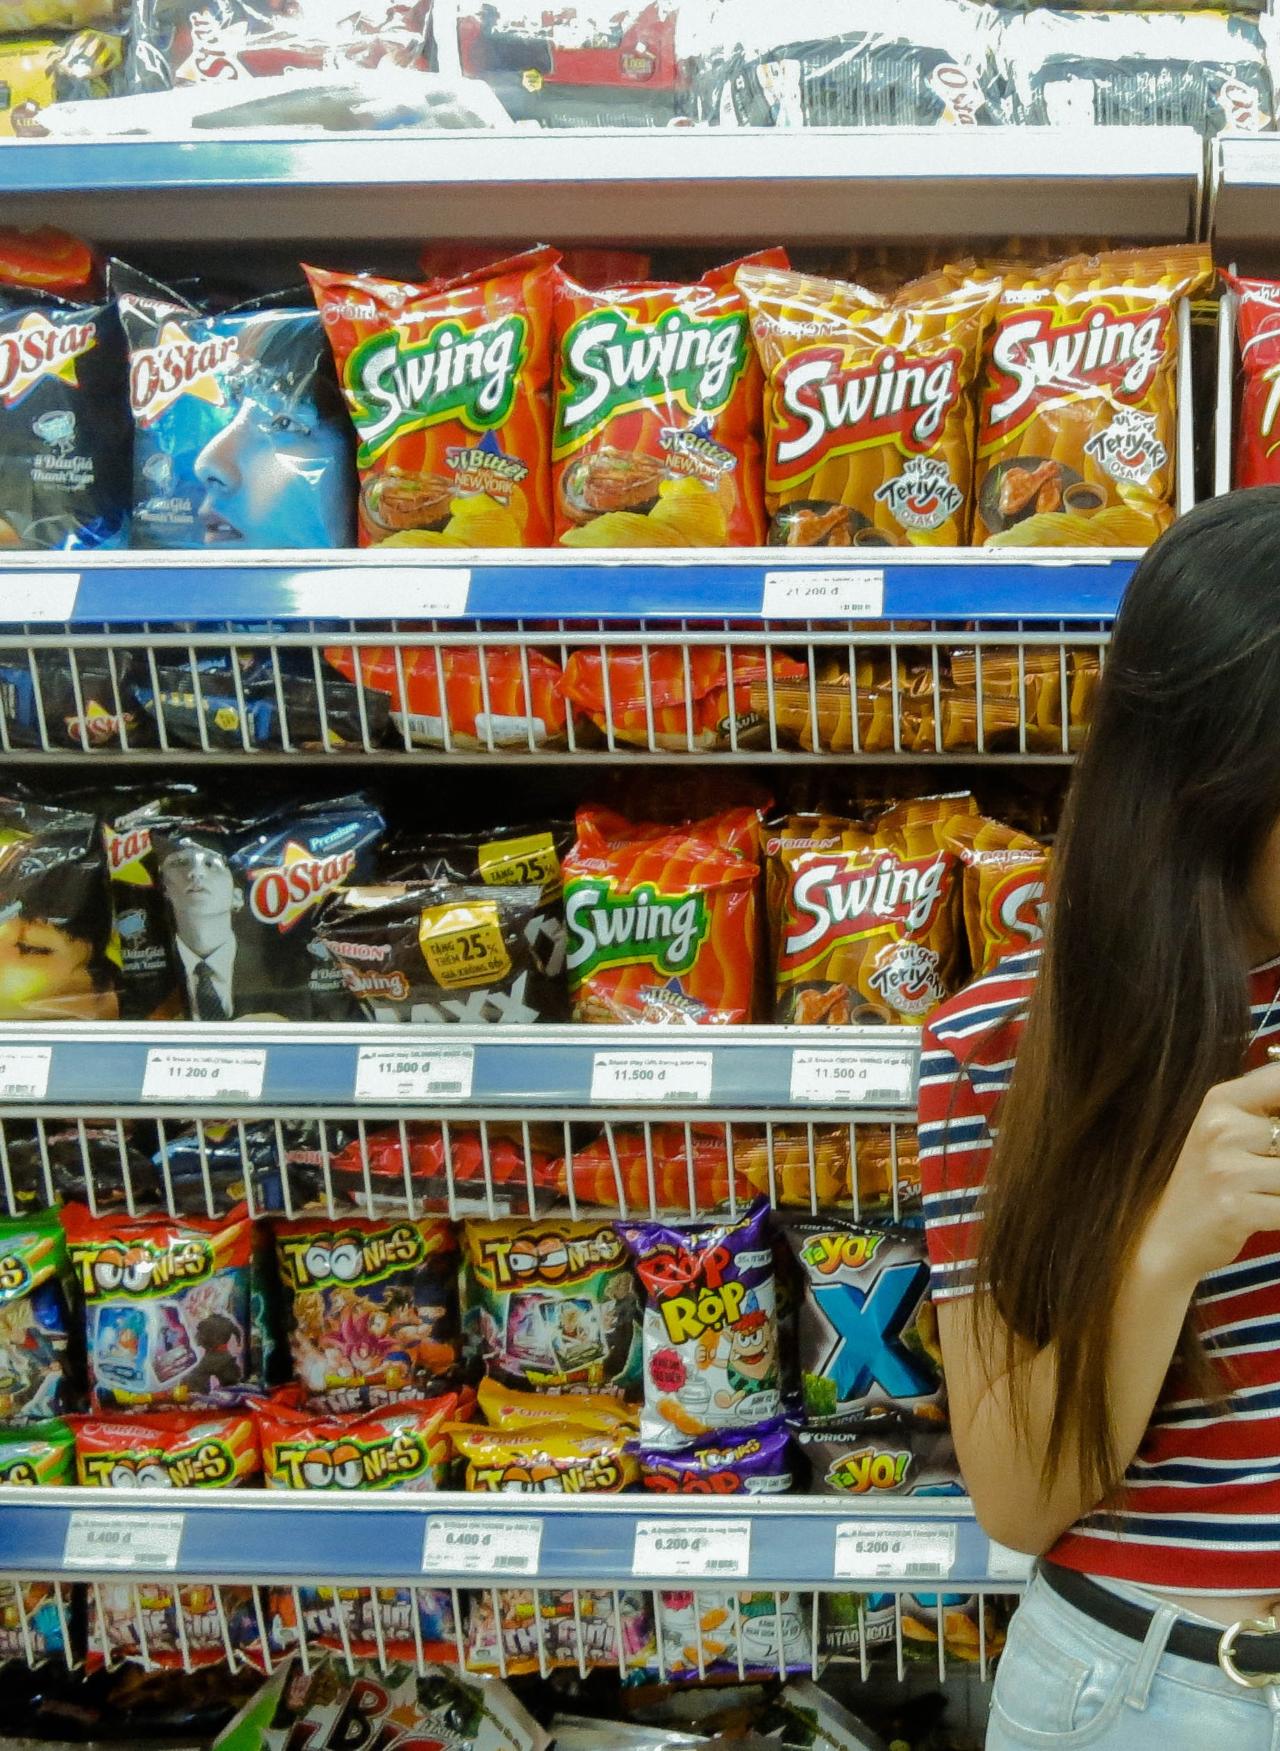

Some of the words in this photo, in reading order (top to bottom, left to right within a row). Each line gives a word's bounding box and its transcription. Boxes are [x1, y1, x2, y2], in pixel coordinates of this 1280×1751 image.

[357, 322, 514, 441] Swing
[565, 318, 741, 427] Swing
[777, 350, 958, 463] Swing
[991, 311, 1164, 425] Swing
[877, 480, 963, 511] Teriyaki
[1085, 432, 1166, 467] Teriyaki
[566, 890, 699, 968] Swing
[786, 859, 946, 954] Swing
